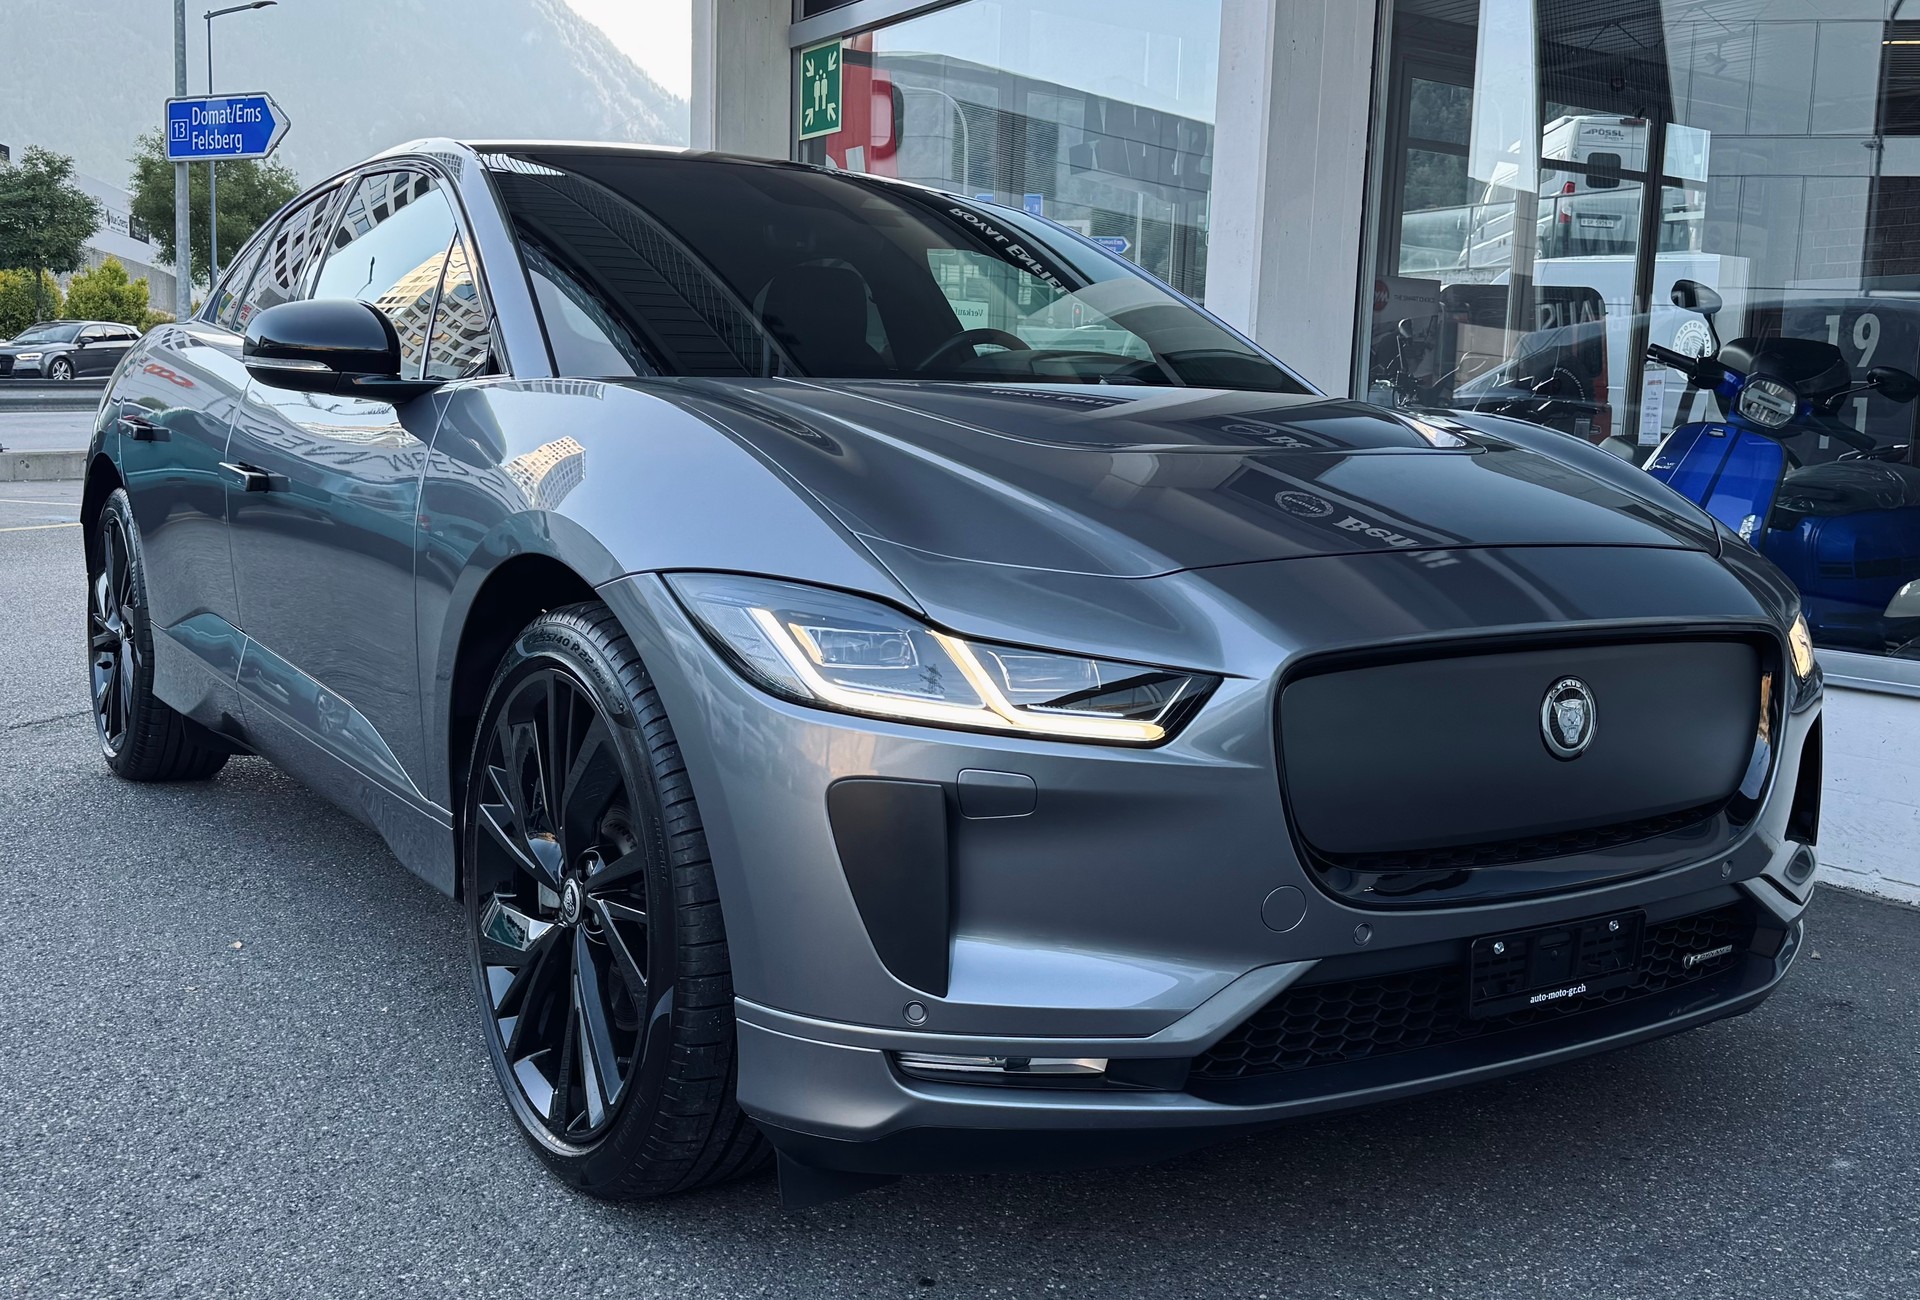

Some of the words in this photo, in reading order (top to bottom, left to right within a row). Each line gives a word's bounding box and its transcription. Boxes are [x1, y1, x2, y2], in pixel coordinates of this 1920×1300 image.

[192, 104, 261, 126] Domat/Ems
[174, 122, 186, 138] 13
[192, 129, 243, 153] Felsberg
[1530, 983, 1587, 1004] auto-moto-gr.ch
